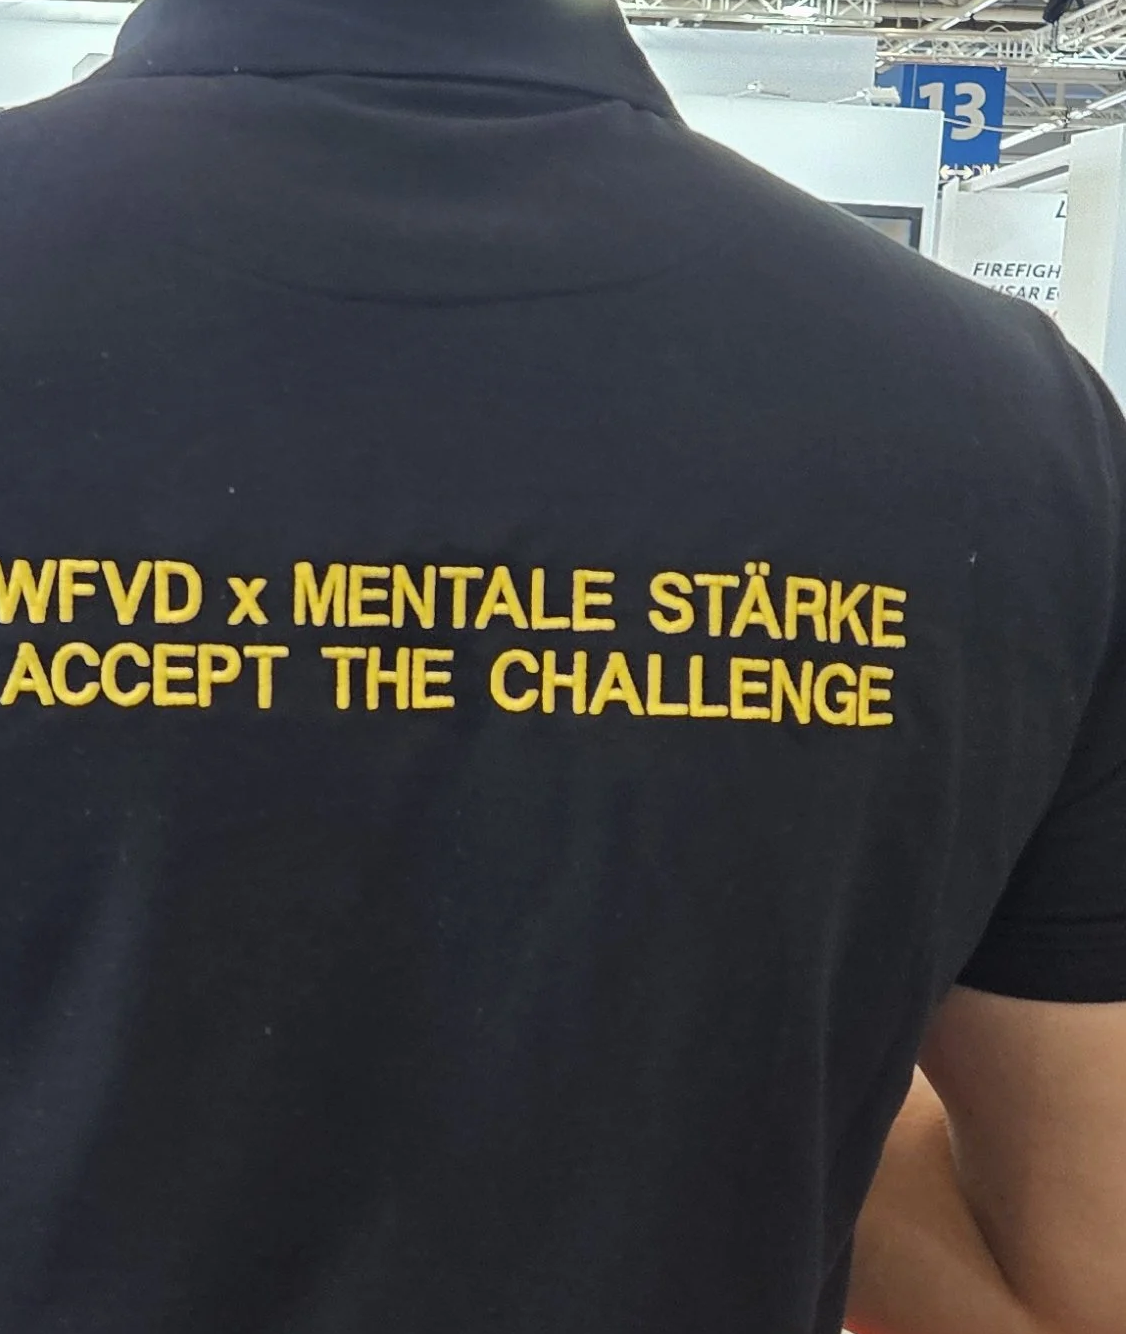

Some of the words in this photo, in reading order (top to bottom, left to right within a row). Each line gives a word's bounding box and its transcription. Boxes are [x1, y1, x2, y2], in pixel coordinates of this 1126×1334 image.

[919, 81, 987, 141] 13
[973, 262, 1062, 279] FIREFIGH
[1045, 286, 1060, 301] E
[228, 577, 268, 626] x
[293, 561, 616, 632] MENTALE
[648, 561, 908, 649] STÄRKE
[0, 641, 289, 710] ACCEPT
[321, 646, 455, 711] THE
[489, 648, 895, 728] CHALLENGE
